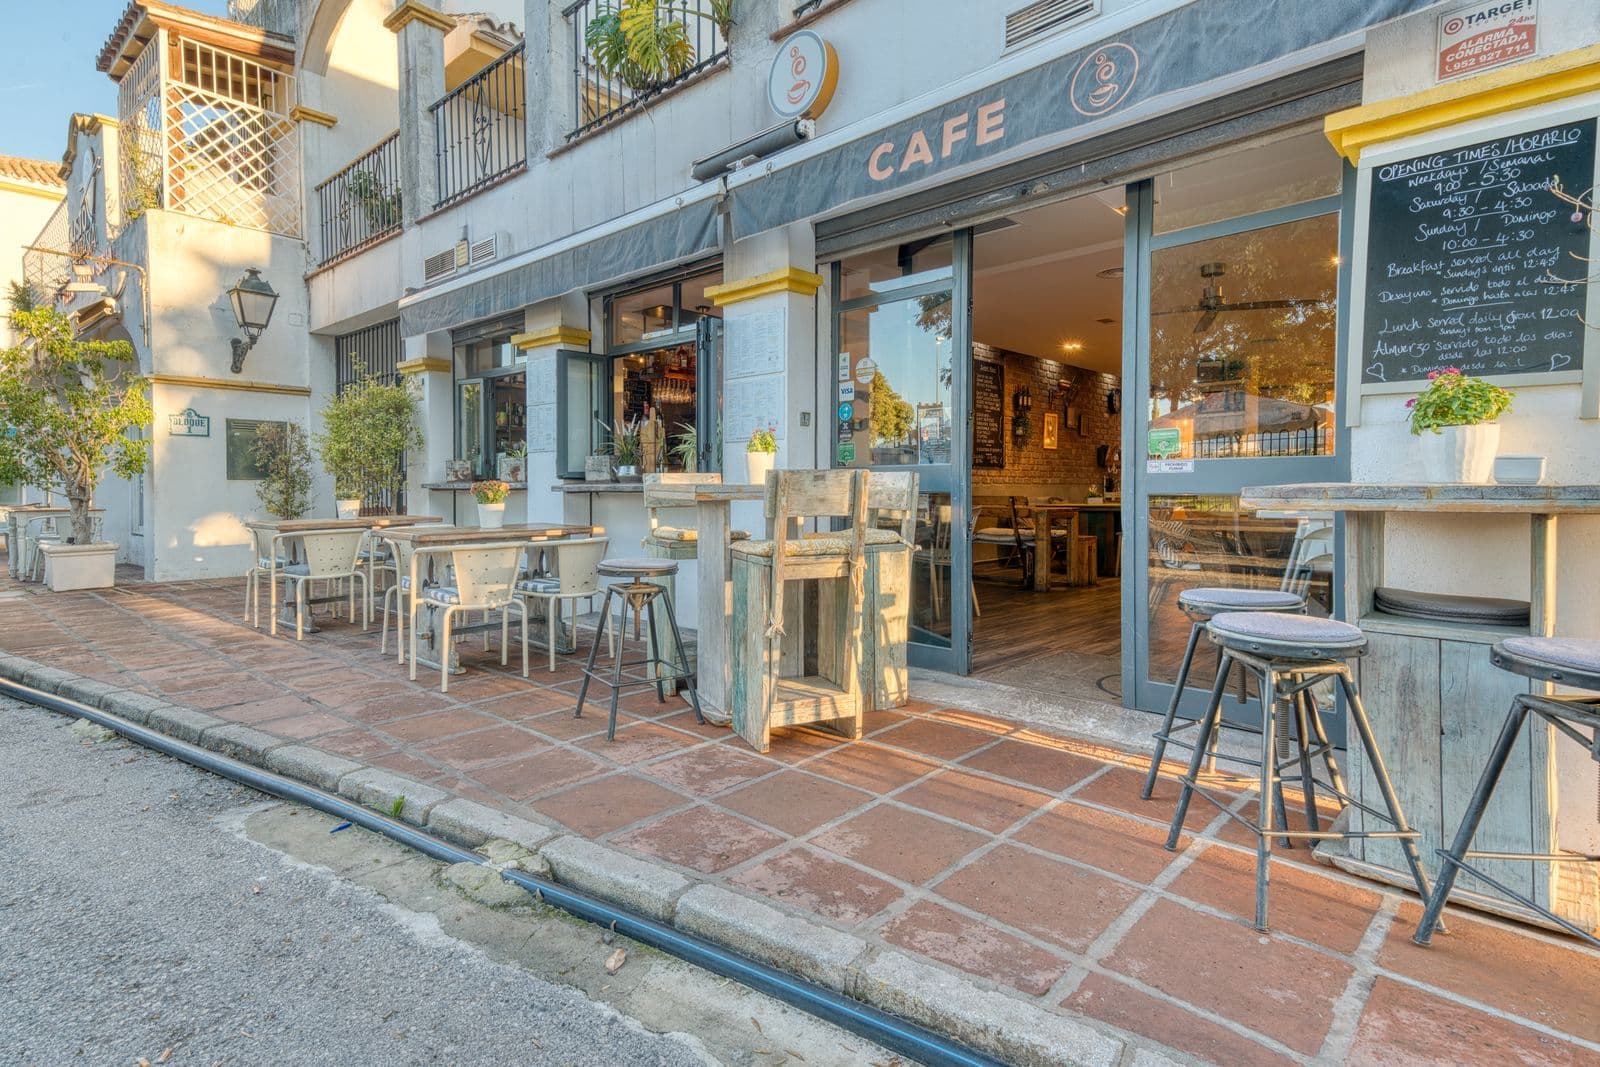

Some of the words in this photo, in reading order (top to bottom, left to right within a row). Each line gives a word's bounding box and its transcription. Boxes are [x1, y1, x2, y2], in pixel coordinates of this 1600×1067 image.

[1446, 32, 1527, 62] CONECTADA
[1459, 28, 1514, 50] ALARMA
[1453, 58, 1476, 71] 952
[1479, 50, 1502, 63] 927
[1506, 42, 1529, 54] 714
[868, 98, 1006, 181] CAFE
[1379, 156, 1447, 181] OPENING
[1453, 143, 1501, 164] TIMES
[1435, 181, 1461, 195] 9:00
[1480, 168, 1521, 186] 5:30
[1409, 194, 1467, 213] Saturday
[1443, 206, 1475, 218] 9:30
[1494, 197, 1532, 212] 4:30
[1415, 222, 1466, 242] Sunday
[1501, 210, 1556, 226] Domingo
[1442, 238, 1478, 250] 10:00
[1496, 229, 1535, 246] 4:30
[1387, 259, 1445, 278] Breakfast
[1498, 249, 1521, 260] all
[1527, 246, 1560, 260] day
[1523, 258, 1556, 269] 12:45
[1378, 290, 1432, 304] Desayuno
[1487, 280, 1511, 288] todo
[1517, 276, 1529, 286] el
[1483, 290, 1510, 300] hasta
[1544, 283, 1578, 296] 12:45
[1379, 317, 1422, 335] Lunch
[1469, 311, 1503, 328] daily
[1506, 310, 1537, 324] from
[1541, 307, 1580, 320] 12:00
[1373, 340, 1430, 359] Almuerzo
[1516, 332, 1537, 342] los
[1439, 351, 1464, 361] desde
[1474, 347, 1492, 357] las
[1497, 345, 1527, 355] 12:00
[1460, 363, 1486, 371] desde
